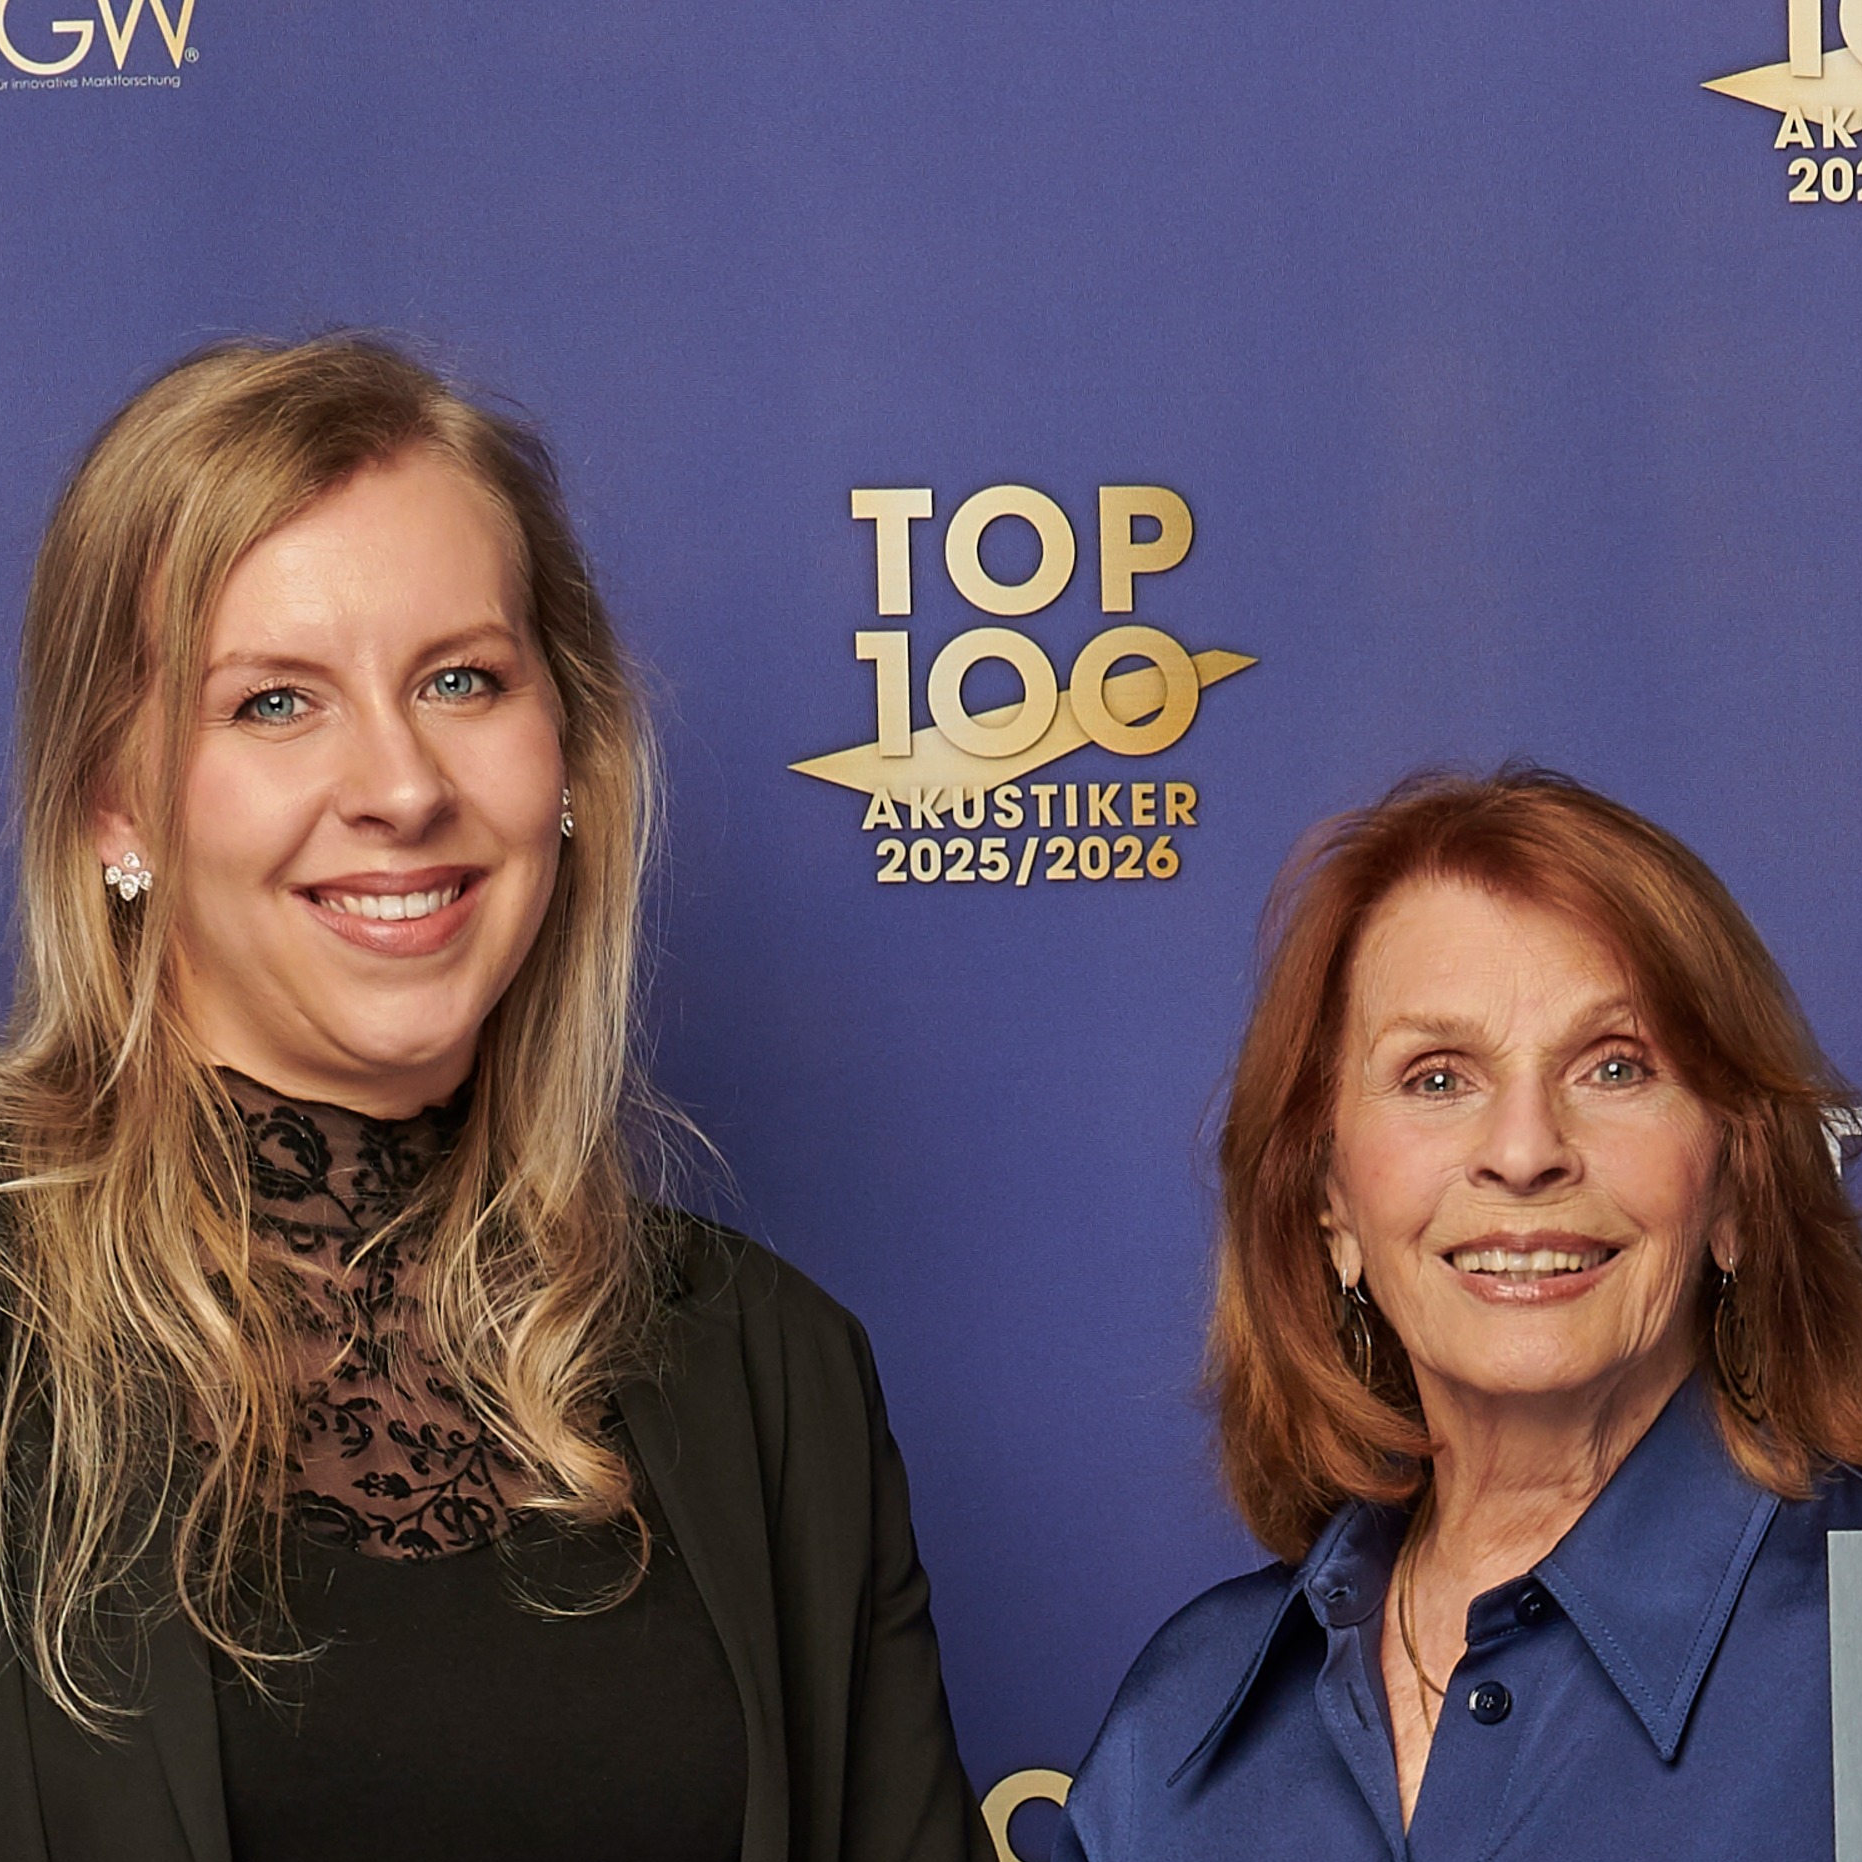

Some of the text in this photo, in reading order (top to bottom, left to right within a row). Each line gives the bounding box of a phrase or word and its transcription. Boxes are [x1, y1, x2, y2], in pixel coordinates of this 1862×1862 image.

[11, 77, 78, 90] innovative
[81, 75, 181, 89] Marktforschung
[851, 484, 1194, 617] TOP
[855, 625, 1200, 758] 100
[862, 782, 1198, 831] AKUSTIKER
[876, 836, 1180, 886] 2025/2026
